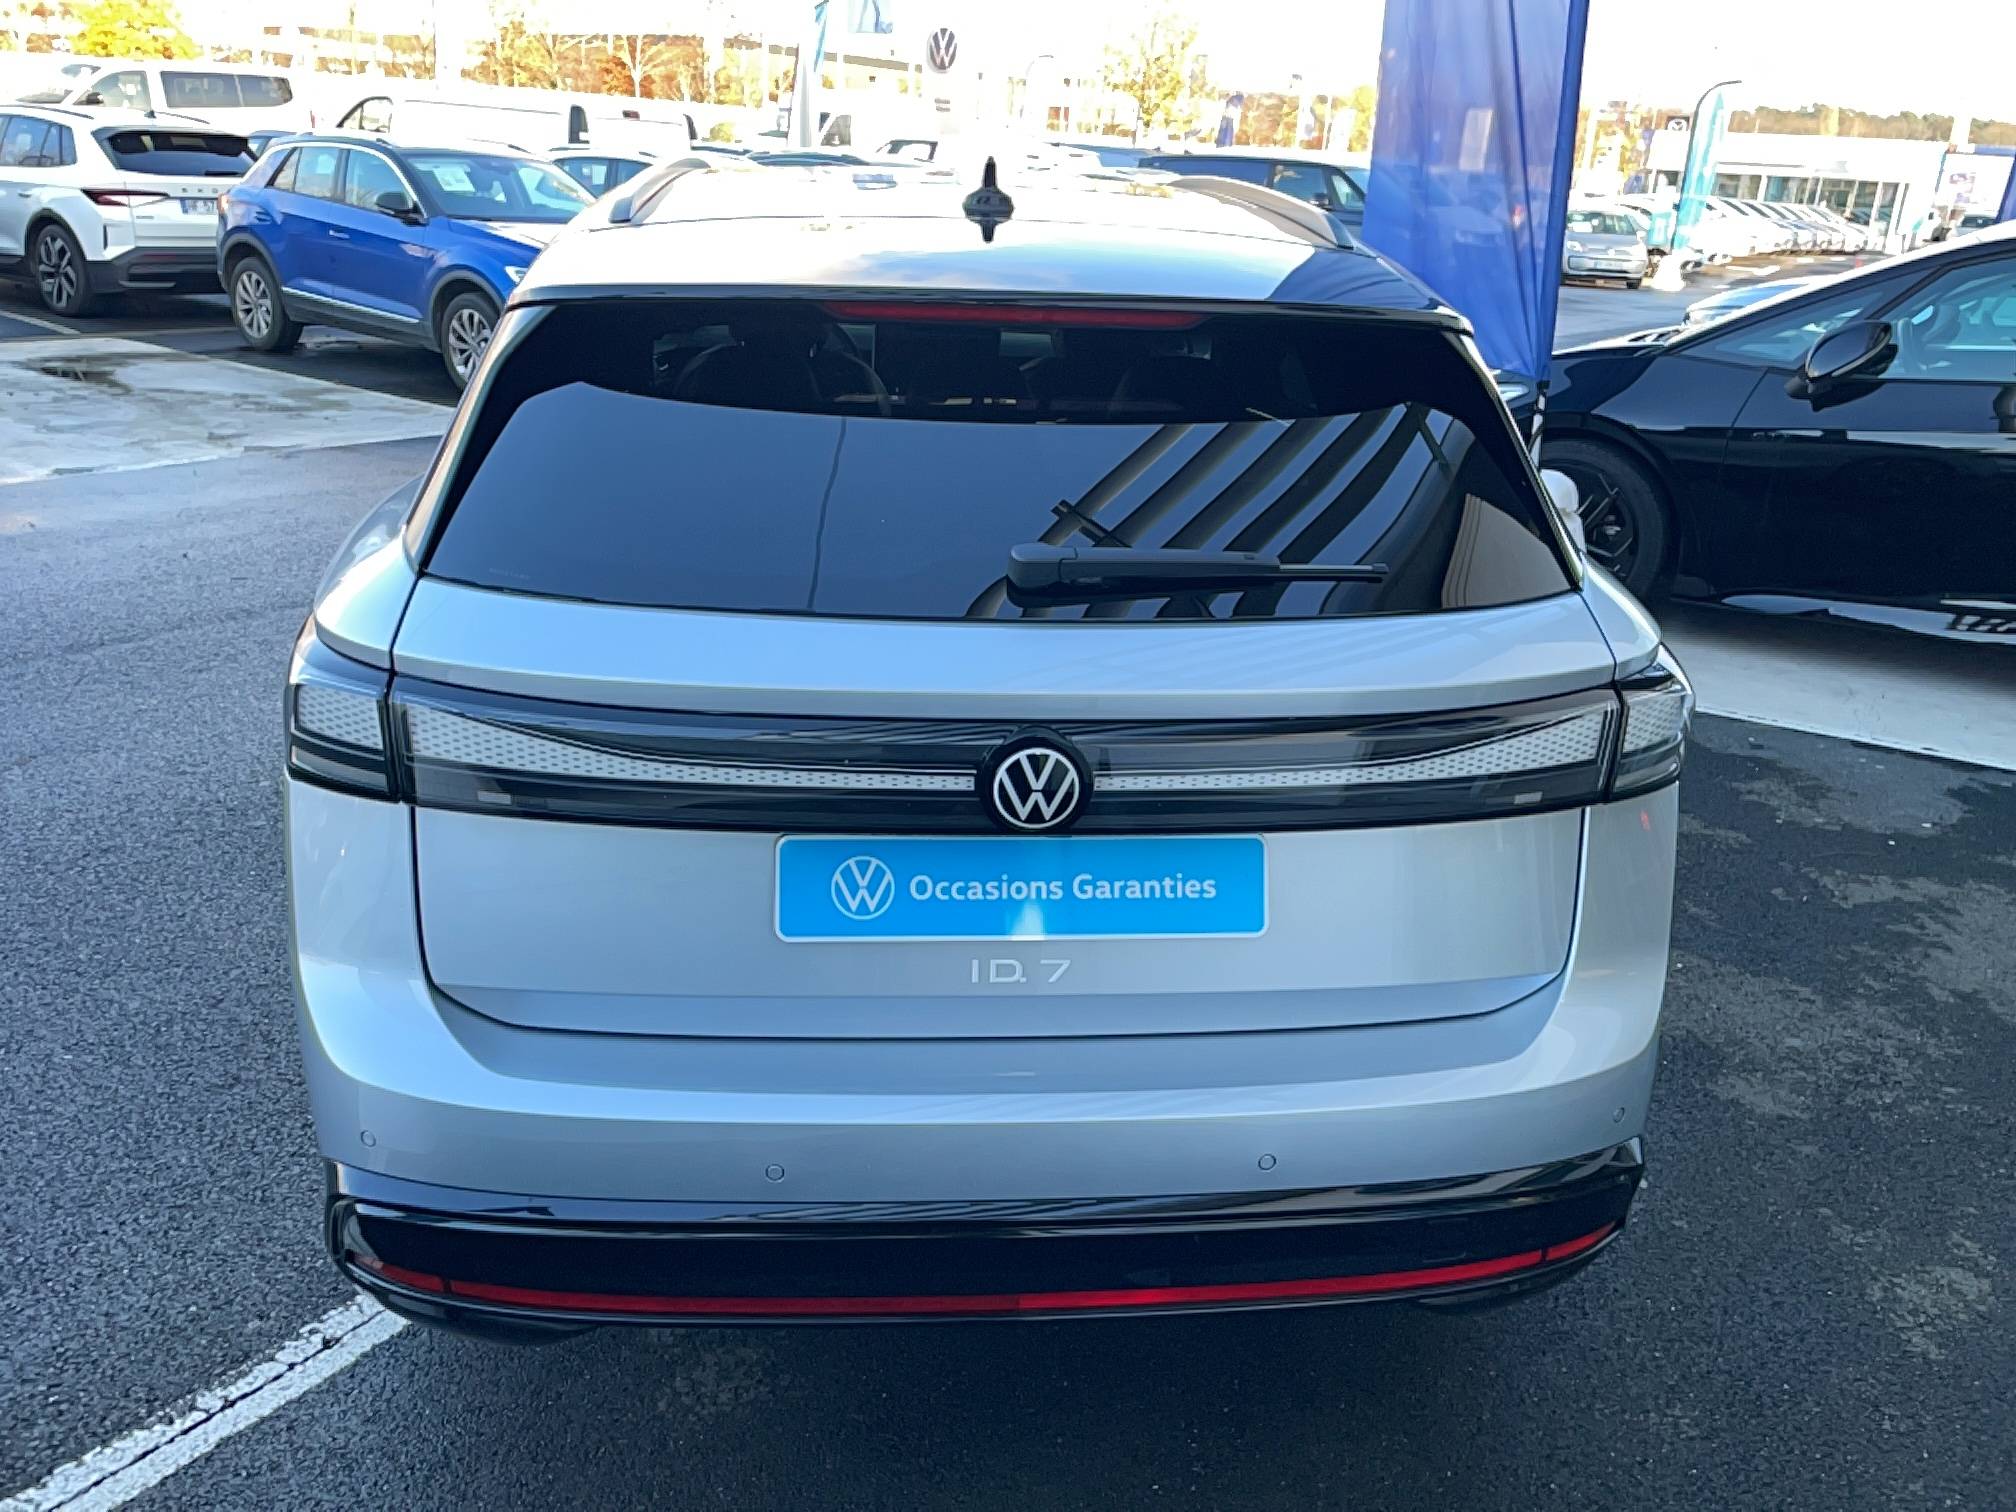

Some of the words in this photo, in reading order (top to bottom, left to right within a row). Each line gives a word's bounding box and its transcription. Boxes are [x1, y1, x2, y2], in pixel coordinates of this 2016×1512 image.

[995, 749, 1079, 826] VW
[910, 874, 1063, 900] Occasions
[1072, 872, 1216, 899] Garanties
[1040, 959, 1071, 982] 7
